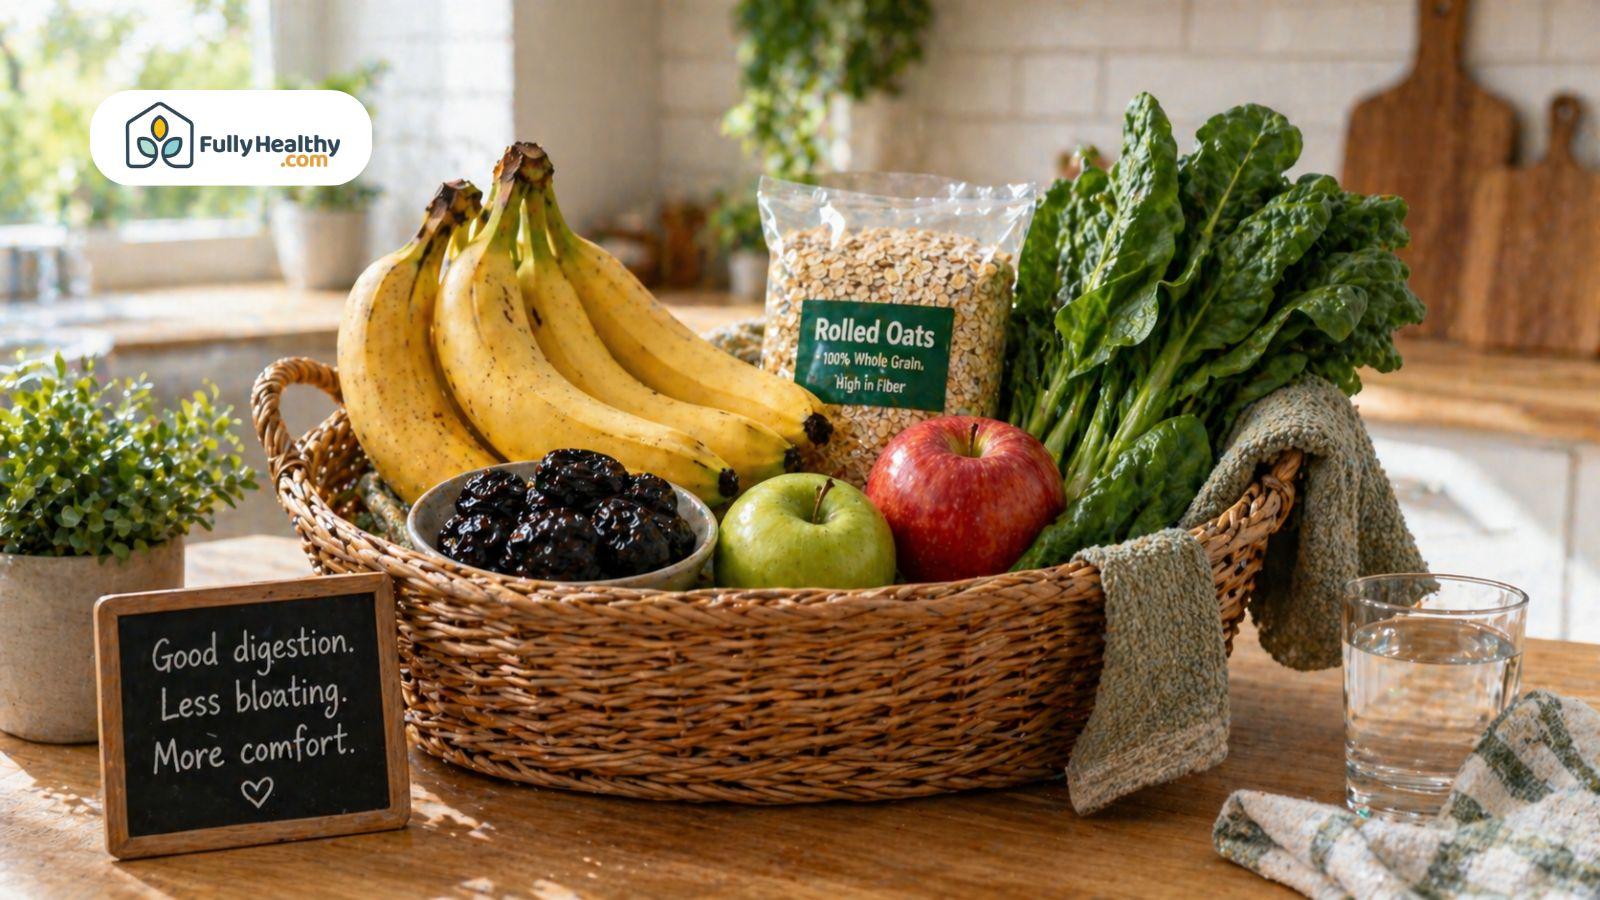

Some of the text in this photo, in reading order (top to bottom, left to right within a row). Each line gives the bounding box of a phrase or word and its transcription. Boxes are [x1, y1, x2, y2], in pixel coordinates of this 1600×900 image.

[814, 317, 935, 348] Rolled Oats
[823, 352, 925, 371] 100% Whole Grain.
[835, 374, 906, 394] High in Fiber
[152, 627, 354, 676] Good digestion.
[161, 675, 347, 722] Less bloating.
[153, 723, 355, 775] More comfort.
